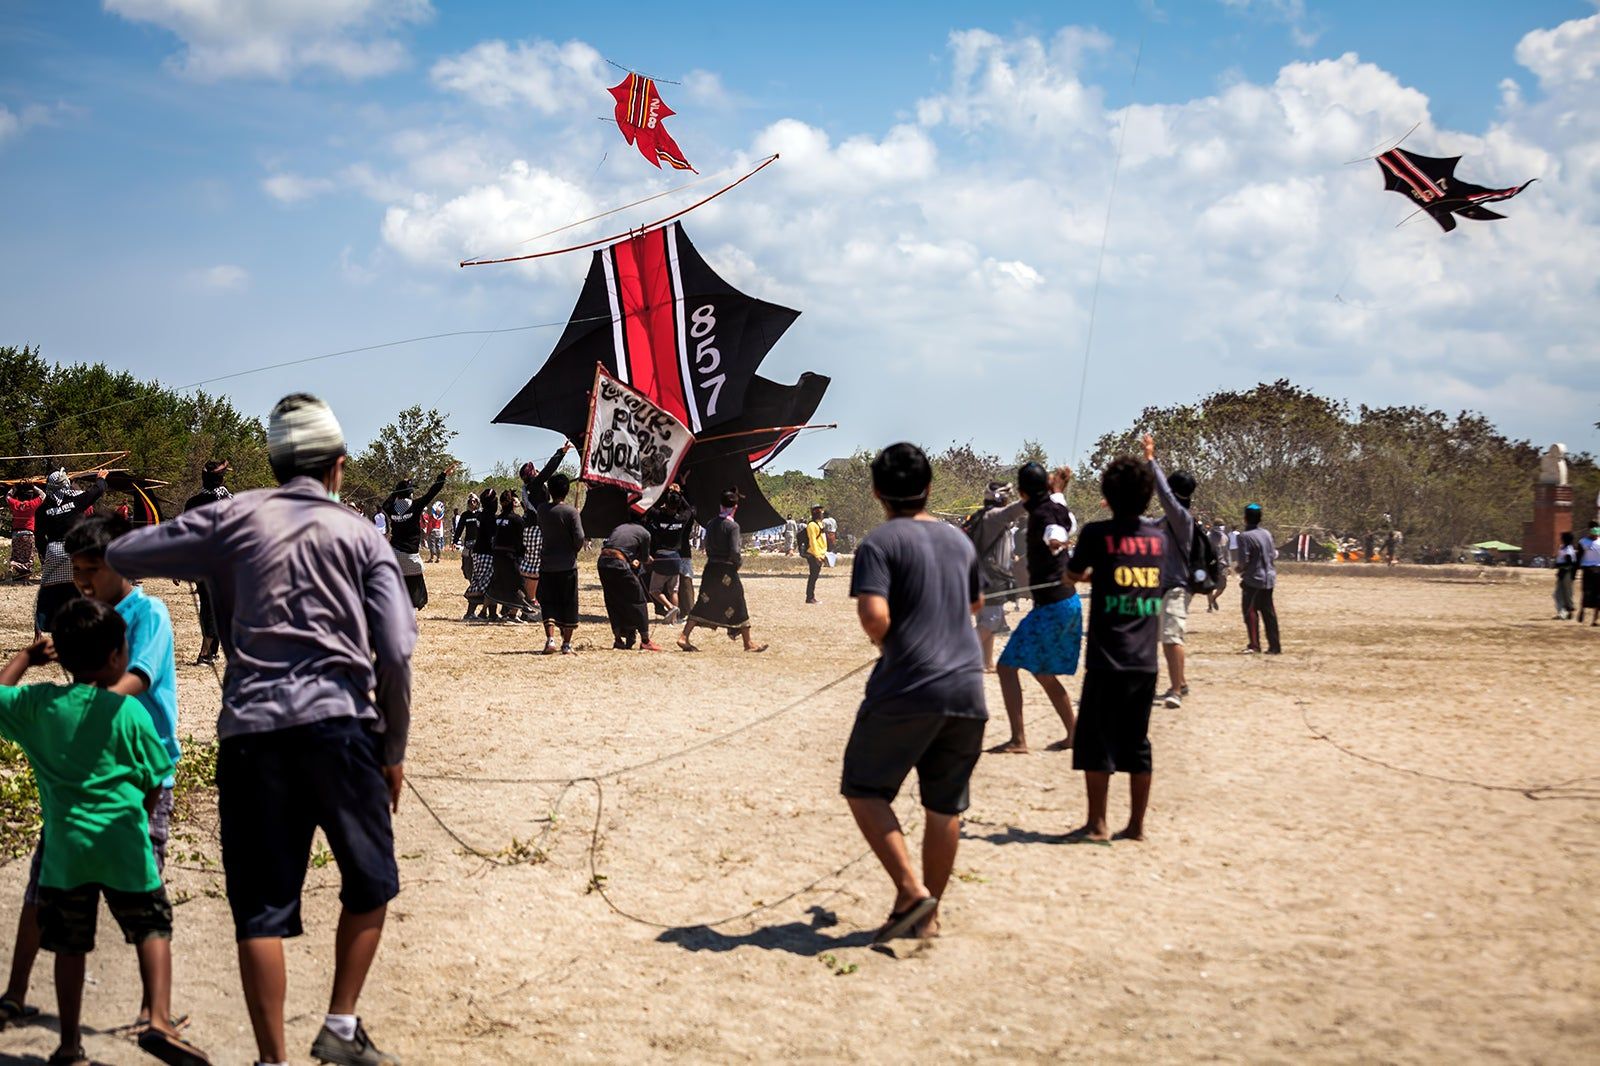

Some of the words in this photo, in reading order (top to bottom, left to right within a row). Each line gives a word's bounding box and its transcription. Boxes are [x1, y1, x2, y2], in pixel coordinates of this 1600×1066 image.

[690, 304, 726, 417] 857
[1104, 535, 1162, 556] LOVE
[1114, 565, 1160, 588] ONE
